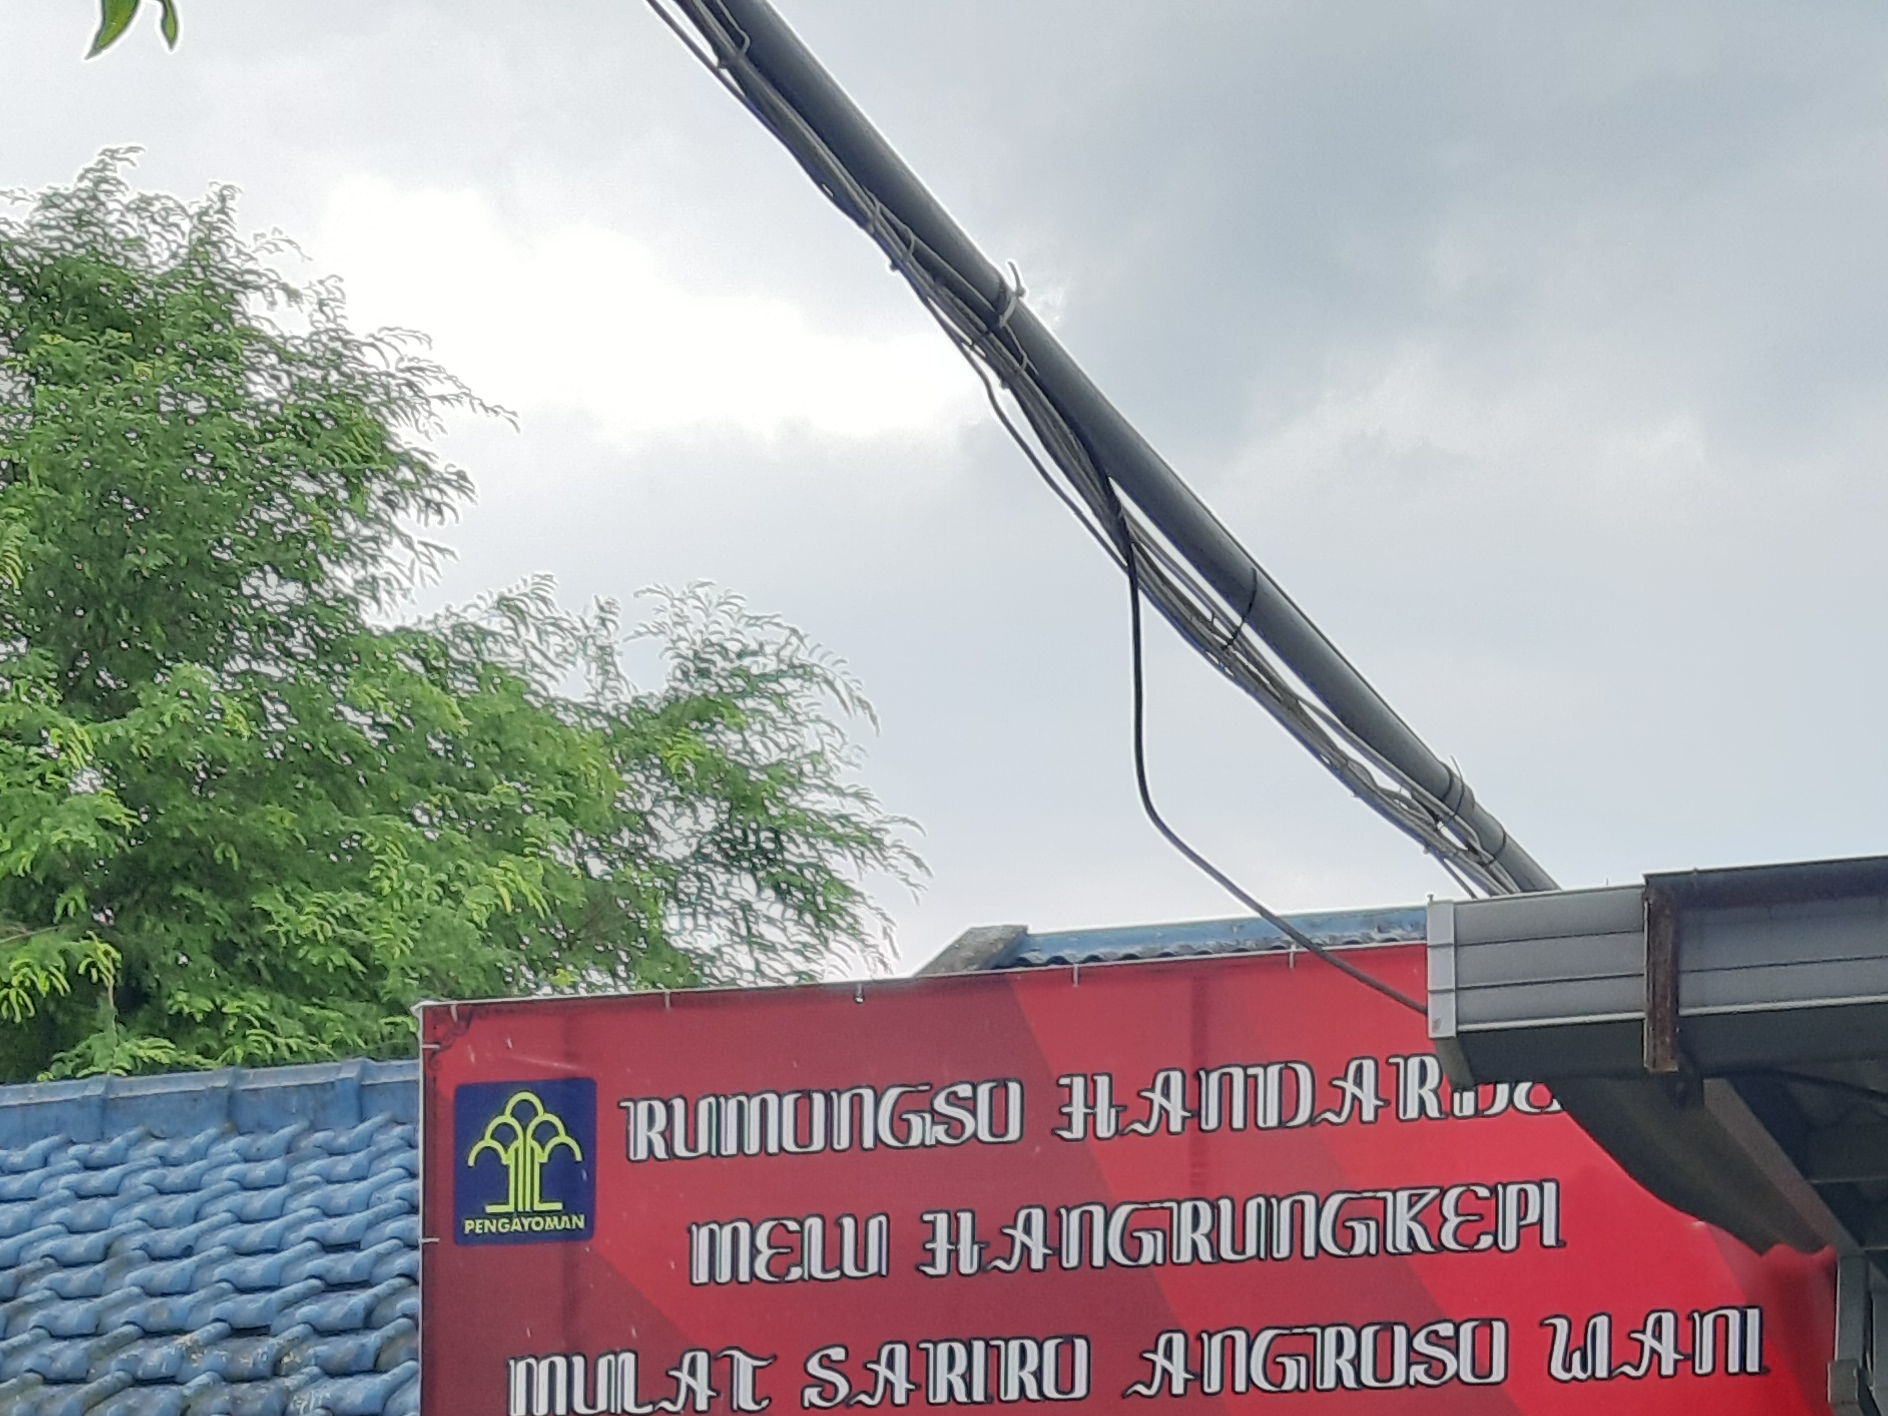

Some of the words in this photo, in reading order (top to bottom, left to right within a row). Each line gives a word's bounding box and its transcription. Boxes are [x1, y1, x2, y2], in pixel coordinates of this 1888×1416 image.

[463, 1213, 585, 1235] PENGAYOMAN
[688, 1213, 889, 1286] MELU
[800, 1335, 1092, 1410] SARIRO
[1123, 1317, 1507, 1398] ANGROSO
[1542, 1305, 1768, 1382] WANI
